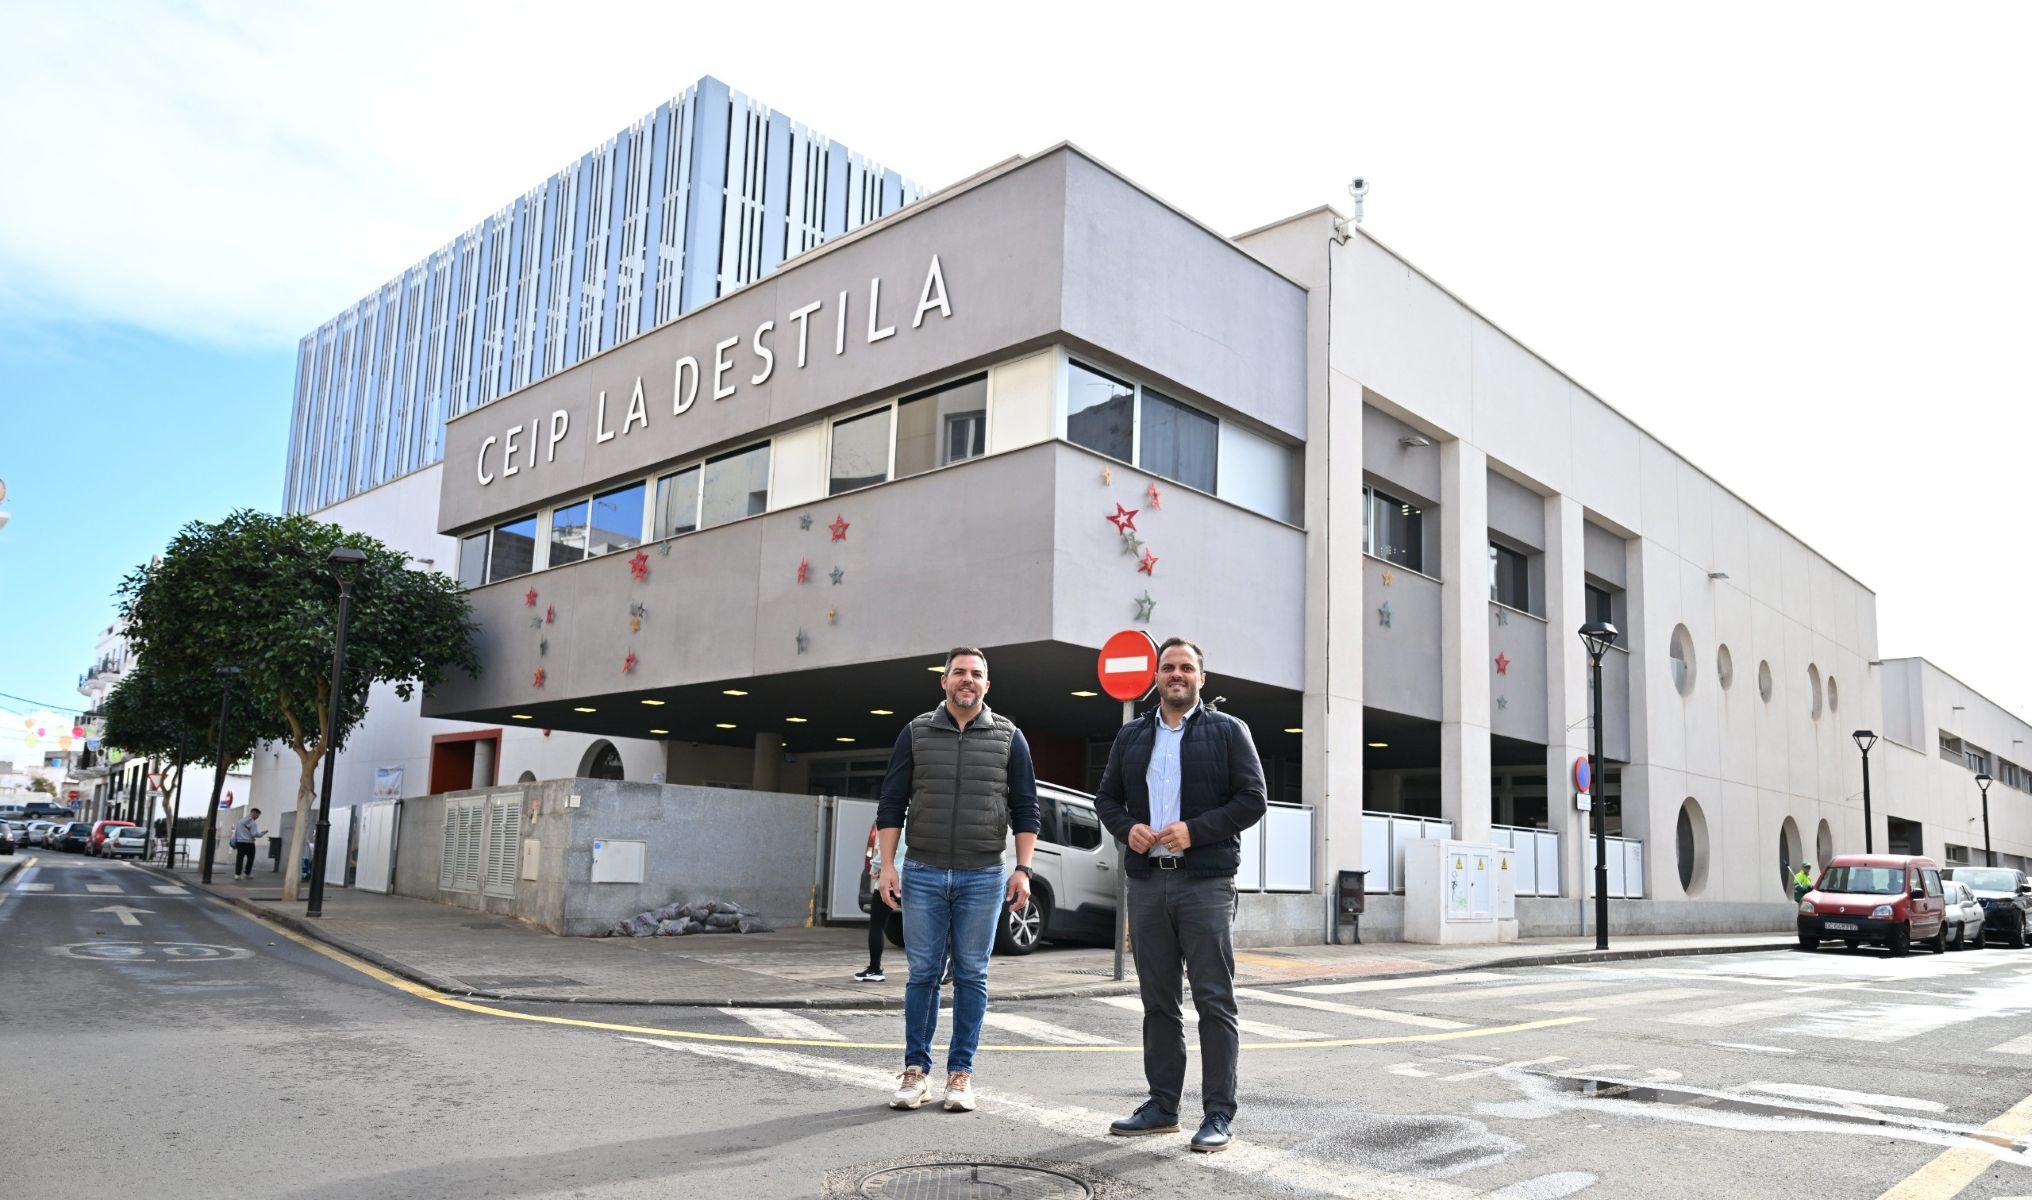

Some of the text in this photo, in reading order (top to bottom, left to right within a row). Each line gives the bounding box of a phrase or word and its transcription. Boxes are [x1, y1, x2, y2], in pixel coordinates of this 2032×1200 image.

[477, 254, 952, 486] CEIP LA DESTILA
